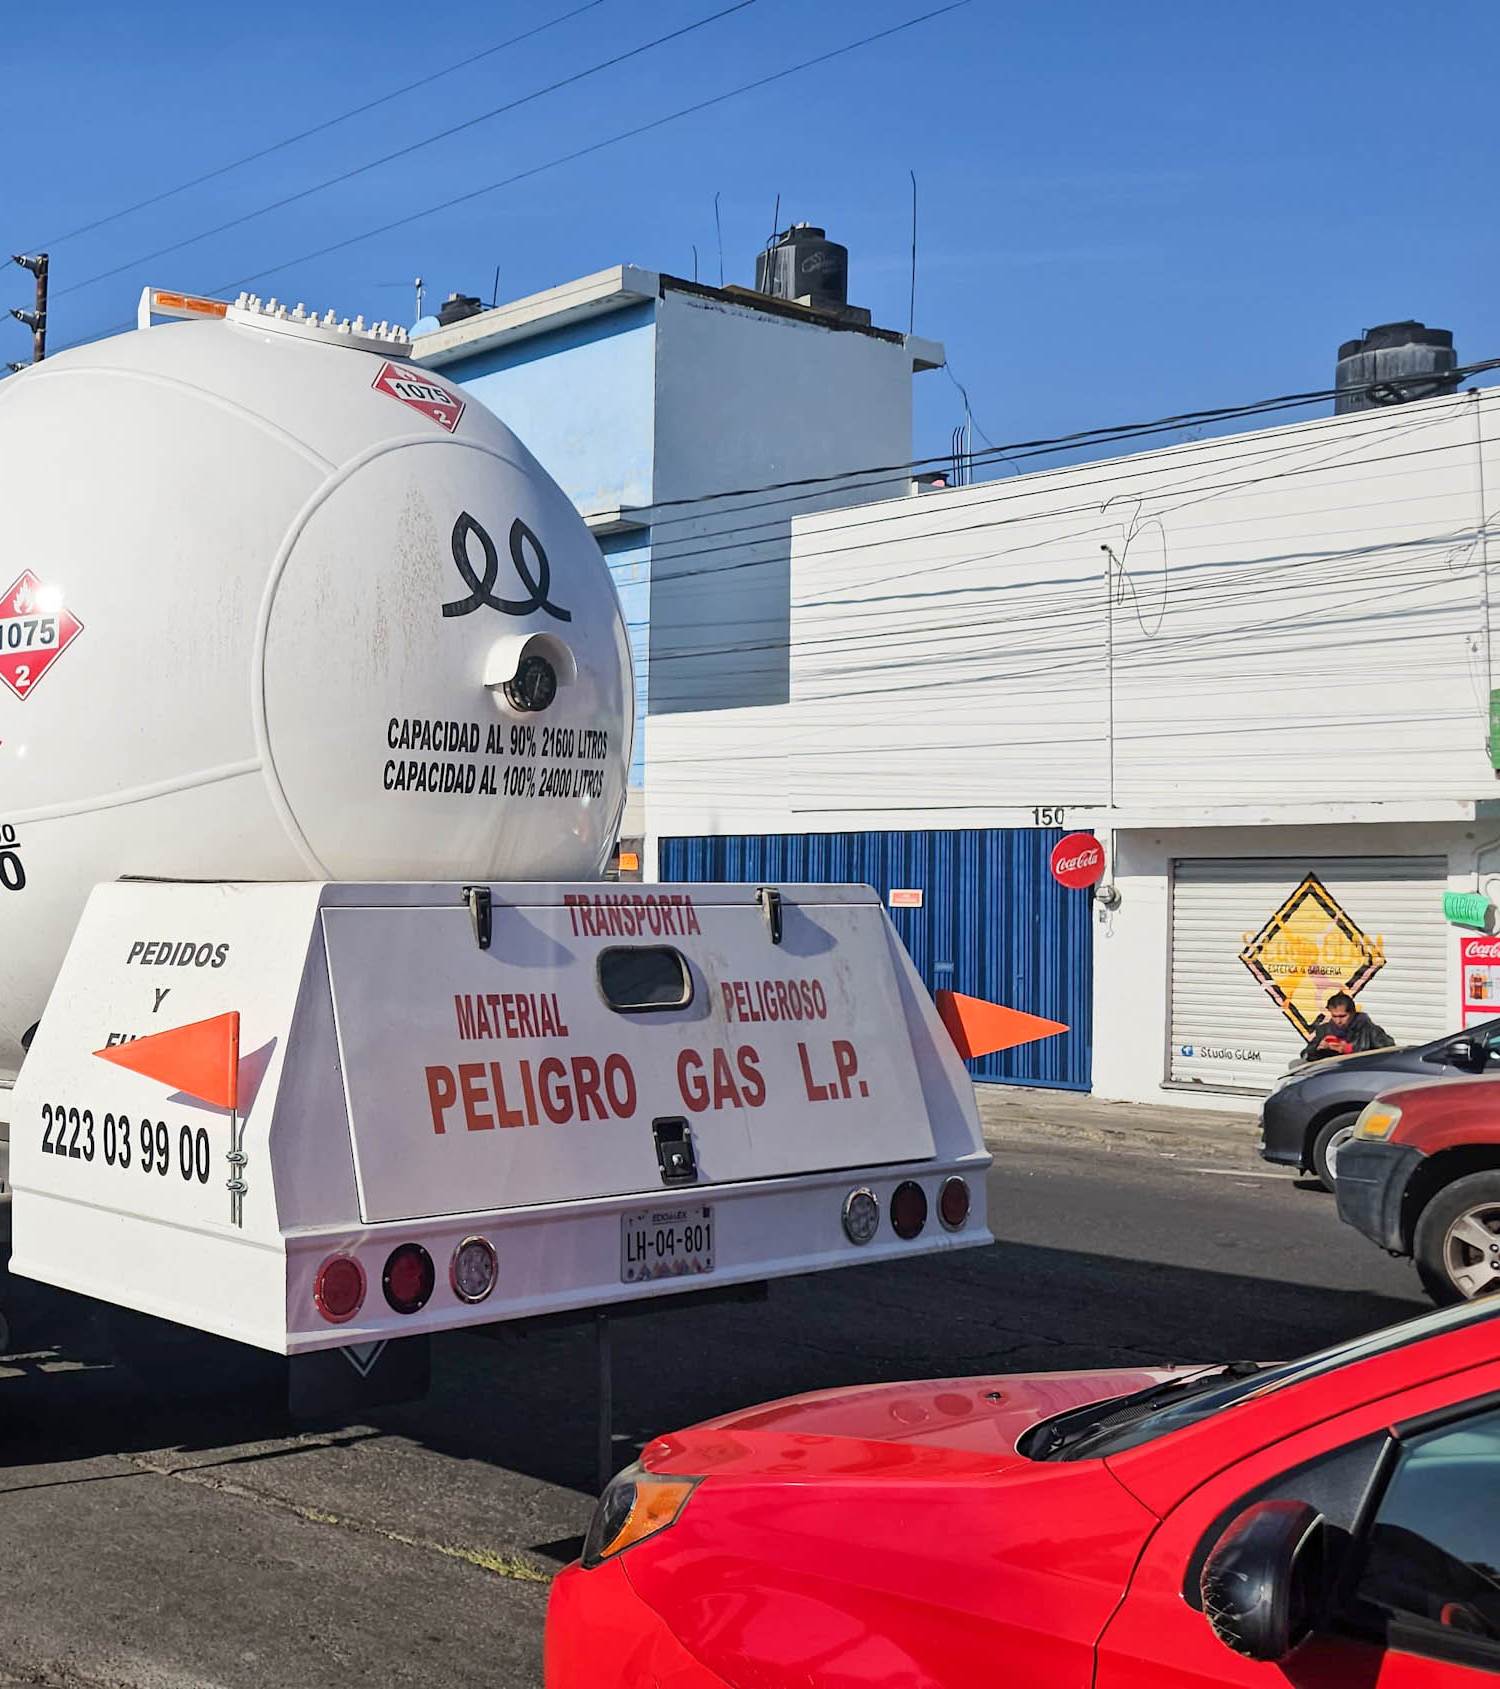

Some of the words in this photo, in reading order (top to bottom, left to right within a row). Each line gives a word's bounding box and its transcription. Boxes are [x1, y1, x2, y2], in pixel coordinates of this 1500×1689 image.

[396, 382, 451, 404] 1075
[433, 410, 451, 424] 2
[14, 665, 31, 687] 2
[387, 718, 480, 753] CAPACIDAD
[485, 724, 504, 755] AL
[510, 725, 536, 758] 90%
[542, 727, 574, 758] 21600
[578, 729, 608, 760] LITROS
[383, 760, 476, 794] CAPACIDAD
[478, 764, 498, 795] AL
[503, 766, 536, 798] 100%
[538, 767, 572, 798] 24000
[572, 768, 604, 799] LITROS
[1032, 807, 1064, 826] 150
[563, 894, 702, 937] TRANSPORTA
[126, 941, 230, 969] PEDIDOS
[152, 988, 171, 1013] Y
[454, 993, 569, 1040] MATERIAL
[720, 978, 827, 1023] PELIGROSO
[1200, 1046, 1233, 1060] Studio
[1234, 1049, 1262, 1060] GLAM
[425, 1052, 638, 1135] PELIGRO
[676, 1044, 767, 1113] GAS
[797, 1039, 870, 1102] L.P.
[41, 1103, 95, 1162] 2223
[104, 1112, 132, 1169] 03
[140, 1118, 170, 1176] 99
[179, 1124, 210, 1184] 00
[628, 1224, 711, 1262] LH-04-801
